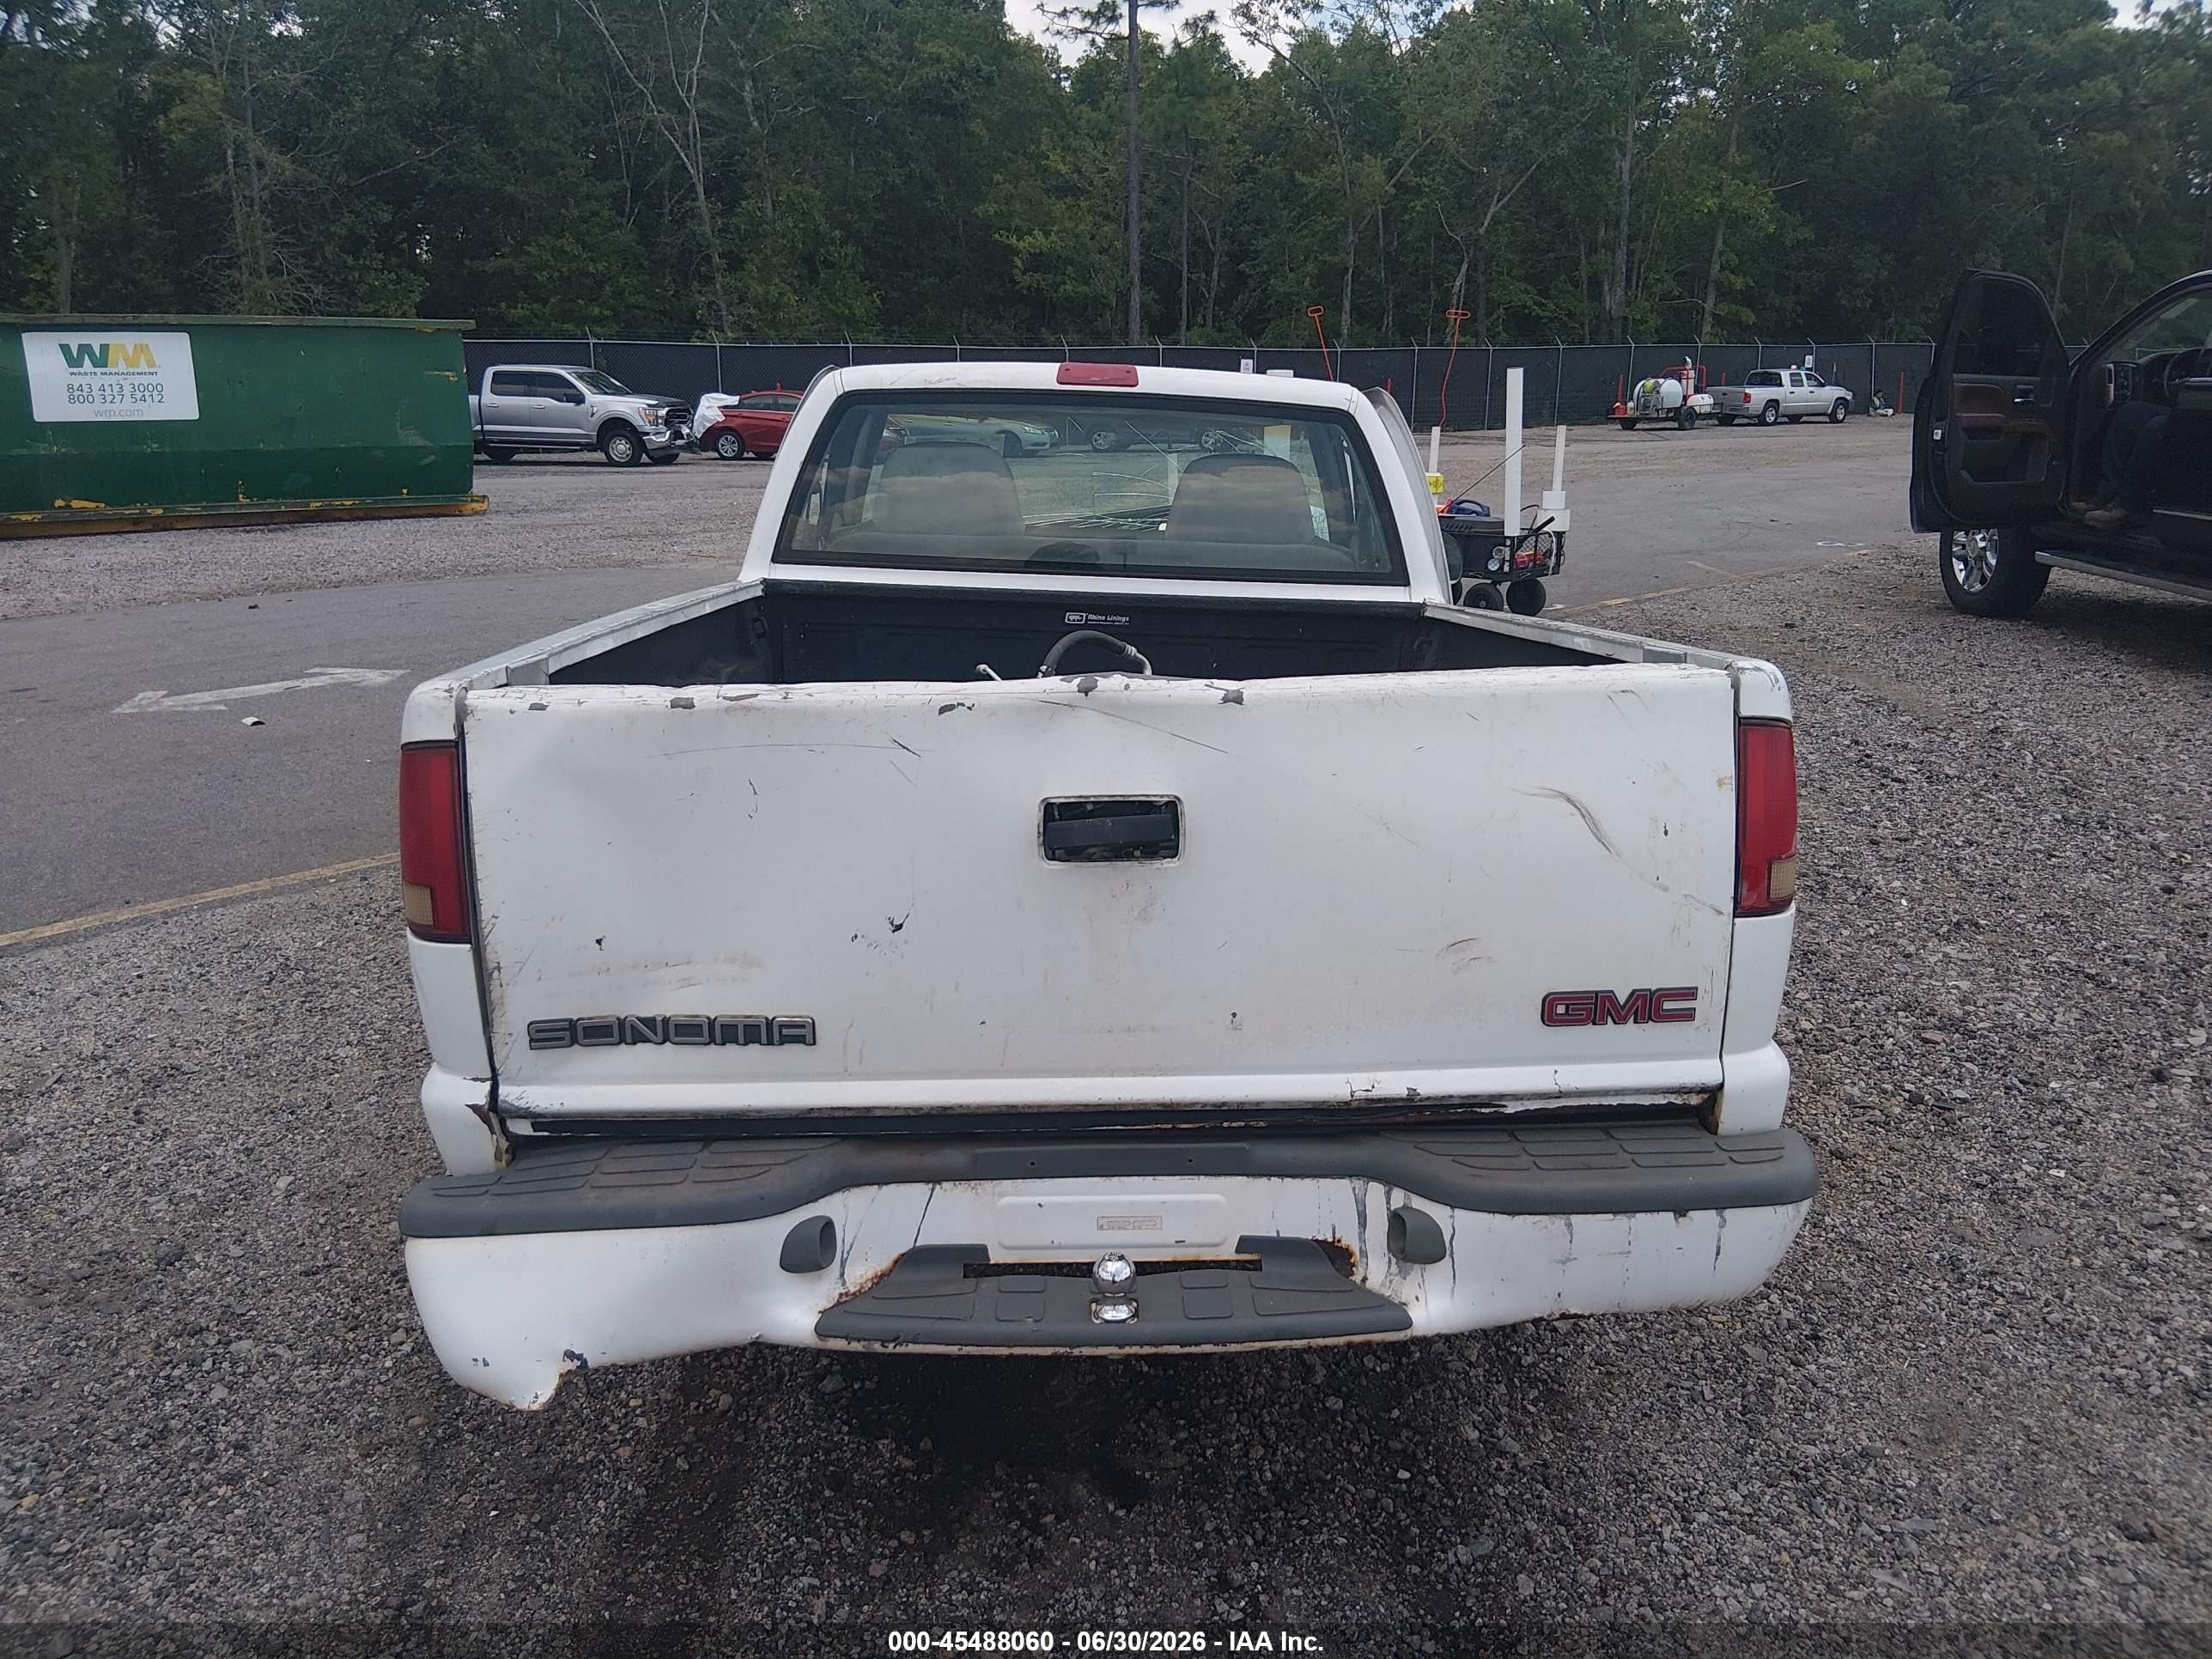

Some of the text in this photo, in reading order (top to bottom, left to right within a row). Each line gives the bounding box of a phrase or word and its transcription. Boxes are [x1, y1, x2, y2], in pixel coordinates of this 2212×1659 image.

[58, 343, 157, 368] WM
[67, 383, 164, 393] 843 413 3000
[68, 393, 165, 404] 800 327 5412
[93, 408, 144, 418] wm.com
[1107, 614, 1130, 623] Linings
[1540, 987, 1698, 1027] GMC
[527, 1014, 817, 1050] SONOMA
